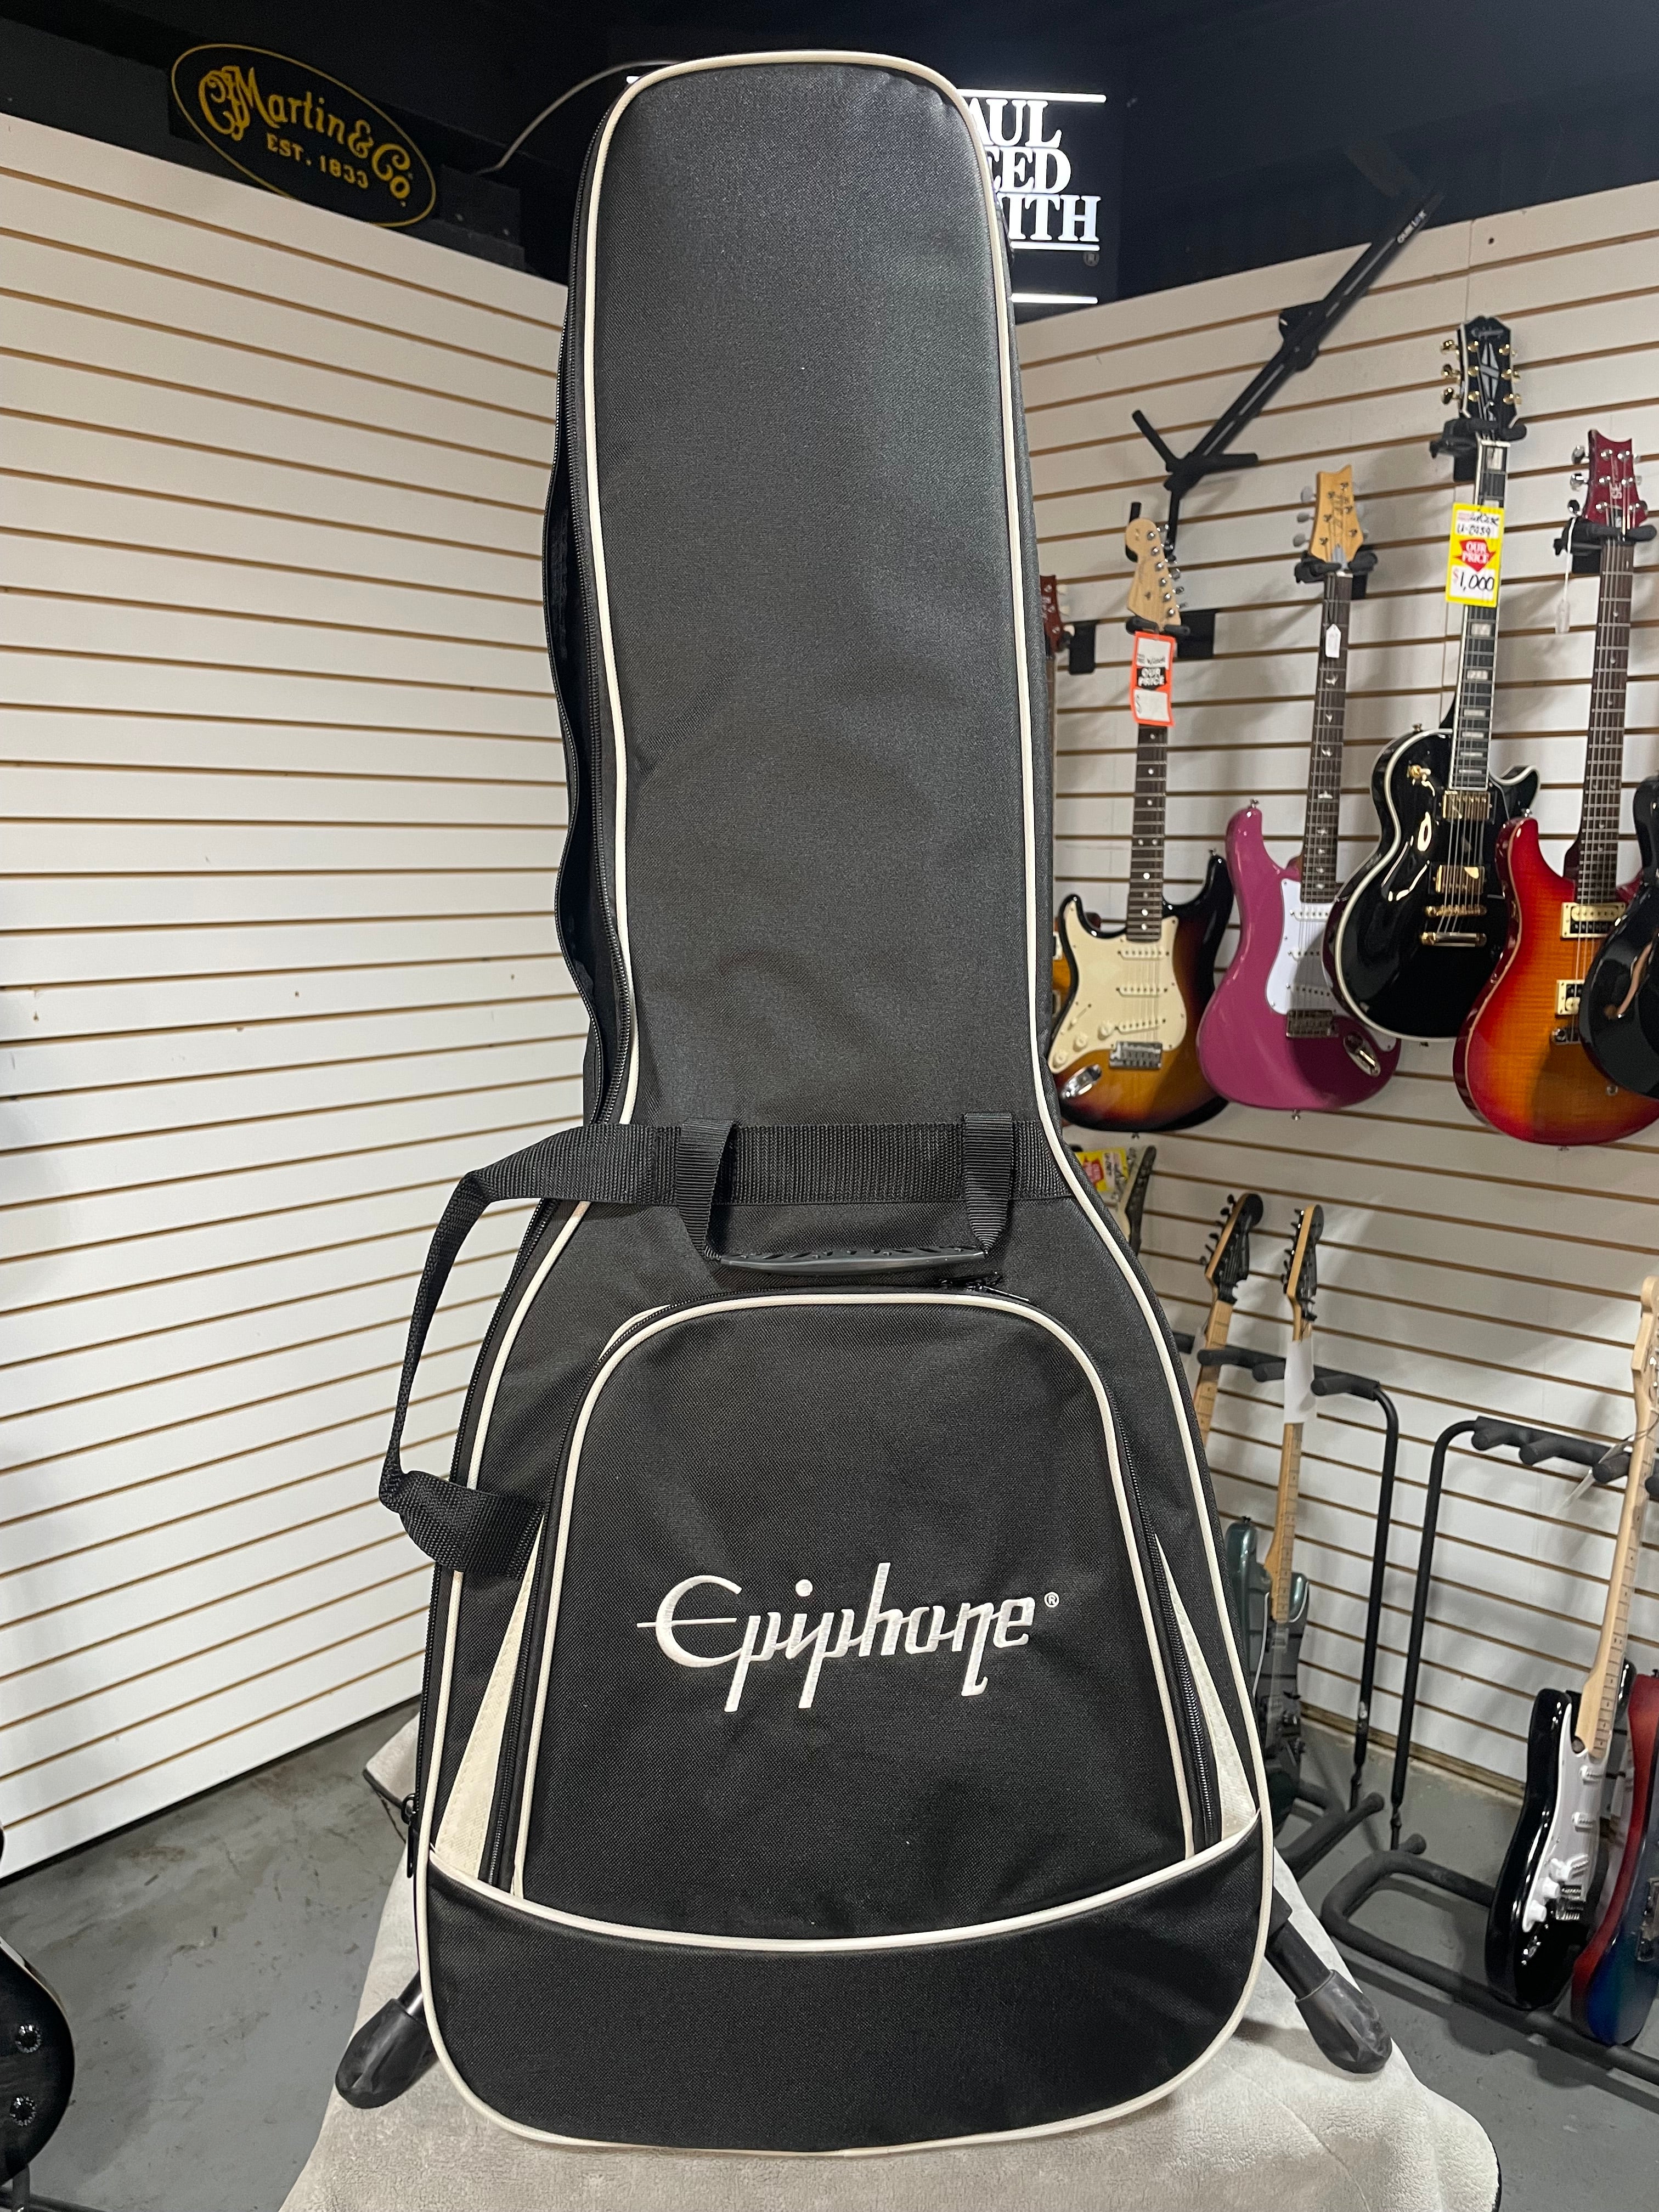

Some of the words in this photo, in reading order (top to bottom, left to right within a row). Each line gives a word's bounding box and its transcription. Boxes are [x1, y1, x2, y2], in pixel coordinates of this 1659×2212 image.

[968, 97, 1062, 148] AUL
[266, 132, 312, 166] EST.
[320, 155, 369, 189] 1833
[984, 146, 1071, 194] ED
[997, 193, 1101, 242] ITH
[1462, 550, 1490, 564] PRICE
[1465, 540, 1487, 554] OUR
[1138, 675, 1165, 686] PRICE
[1141, 667, 1161, 678] OUR
